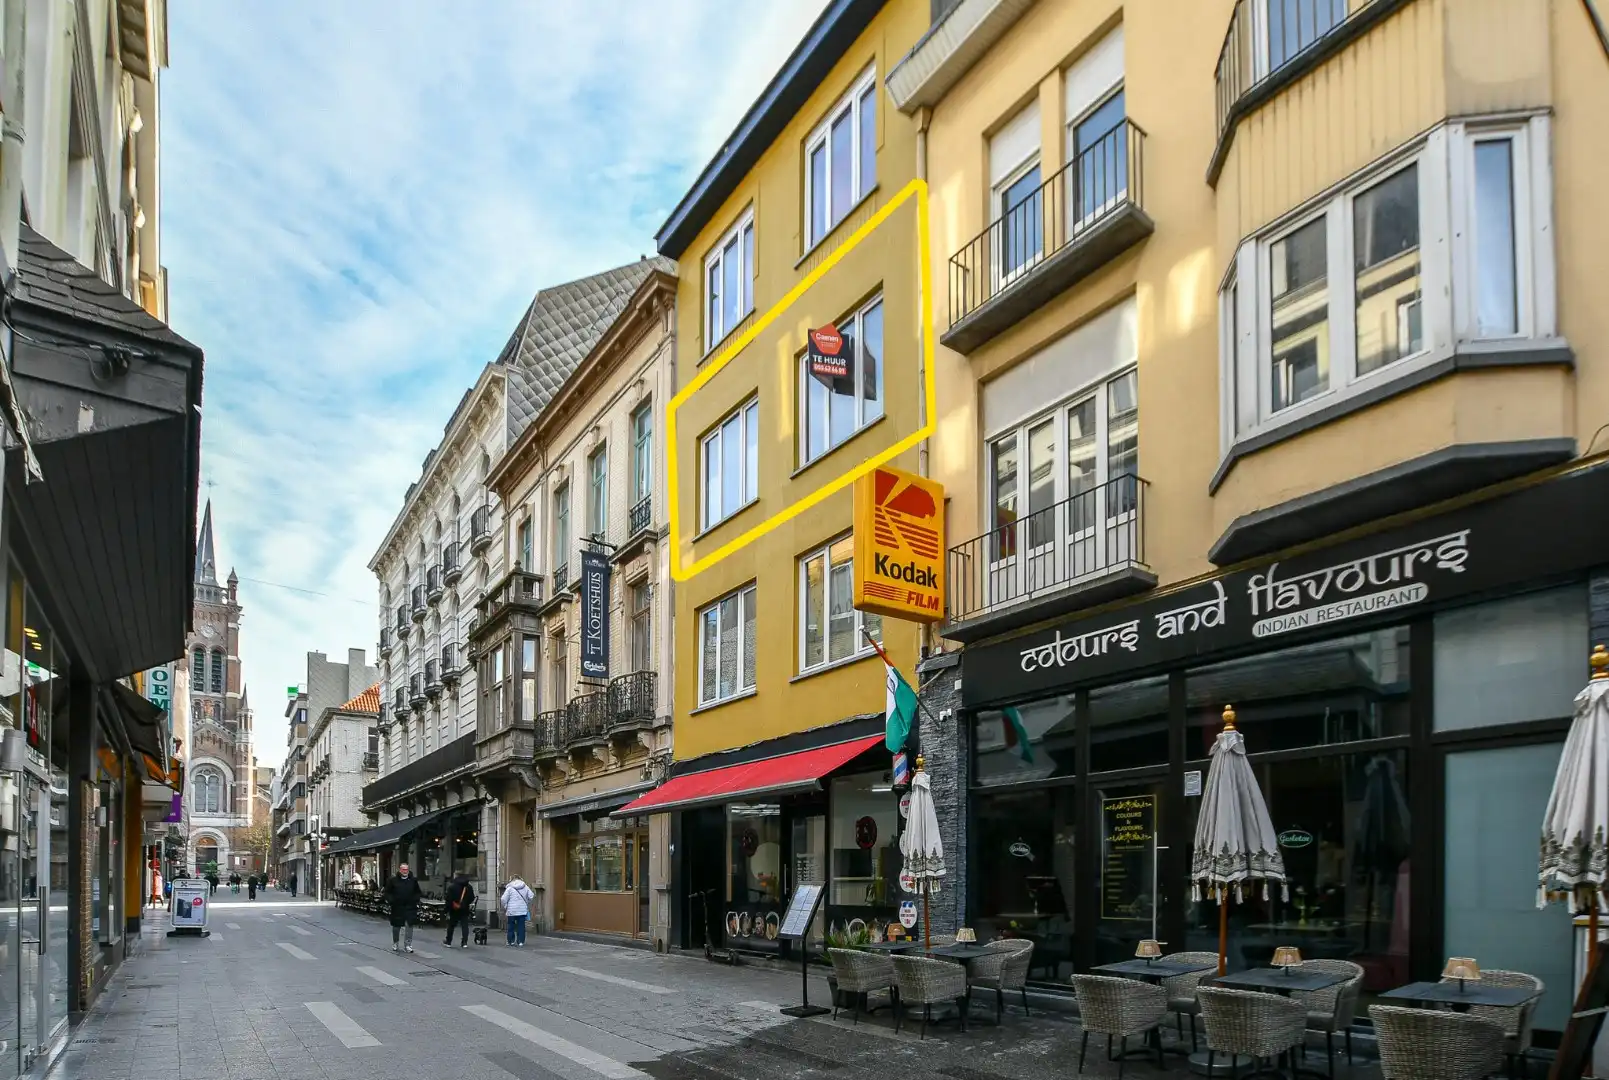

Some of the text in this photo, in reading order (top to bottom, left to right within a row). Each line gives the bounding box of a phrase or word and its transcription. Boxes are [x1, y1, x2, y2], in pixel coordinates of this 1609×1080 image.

[824, 357, 846, 367] HUUR
[874, 551, 939, 590] Kodak
[906, 590, 940, 612] FILM
[1020, 528, 1471, 673] colours and flavours
[1257, 586, 1423, 638] INDIAN RESTAURANT
[149, 664, 171, 711] OEM
